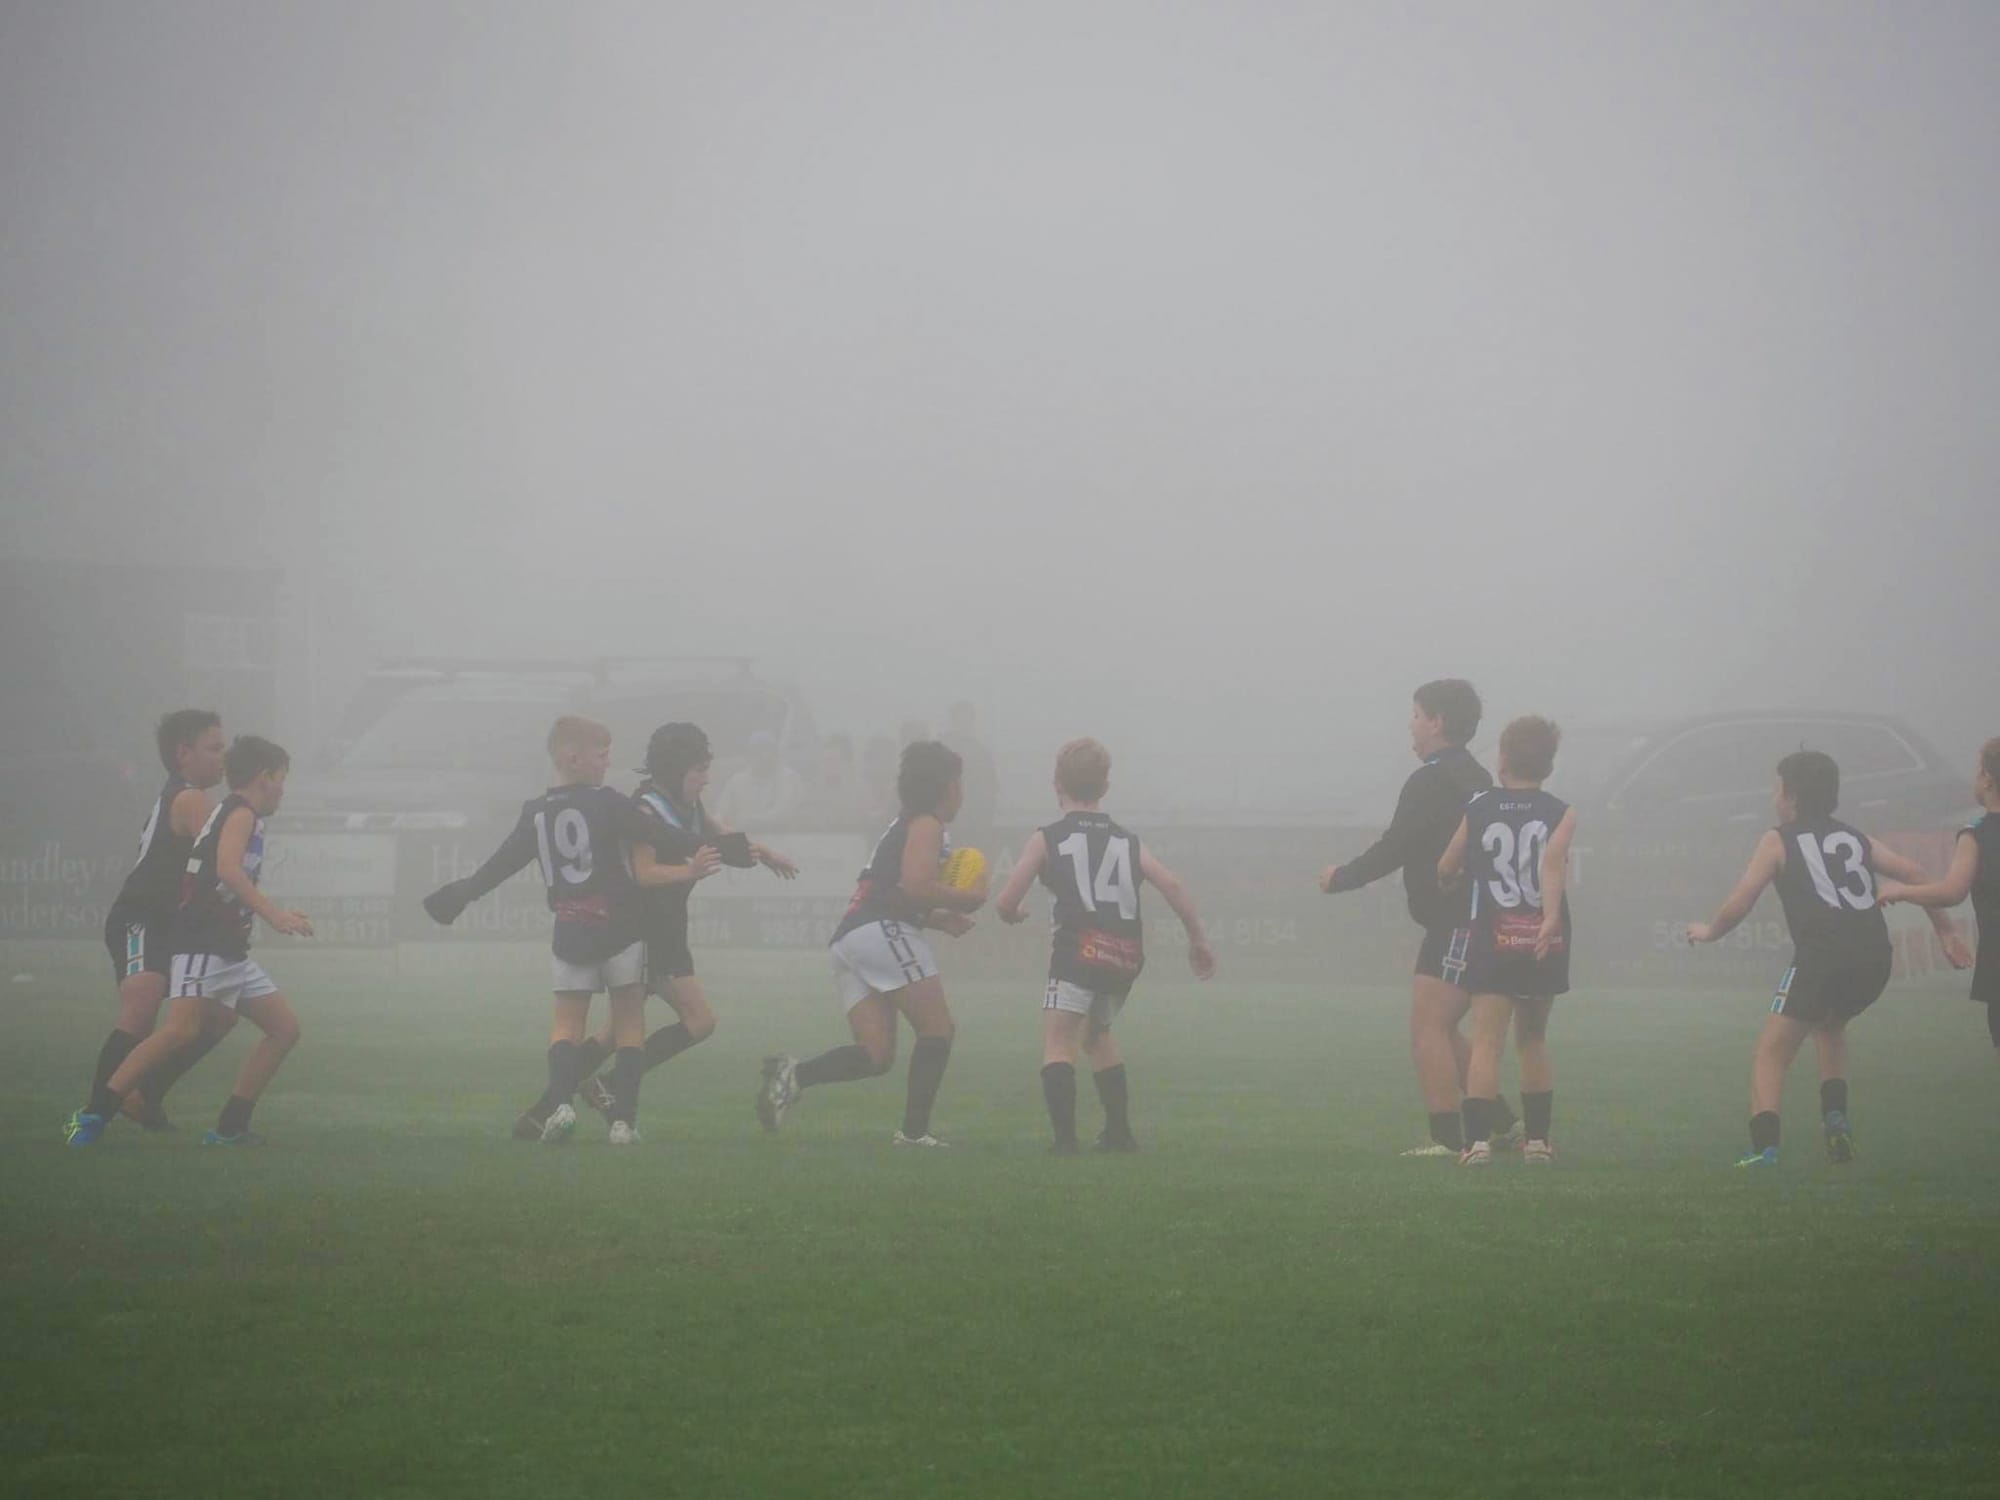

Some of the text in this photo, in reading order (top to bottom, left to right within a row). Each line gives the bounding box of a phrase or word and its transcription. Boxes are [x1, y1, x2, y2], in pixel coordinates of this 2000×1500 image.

[534, 808, 593, 887] 19
[1057, 832, 1138, 920] 14
[1482, 820, 1549, 908] 30
[1796, 831, 1875, 911] 13
